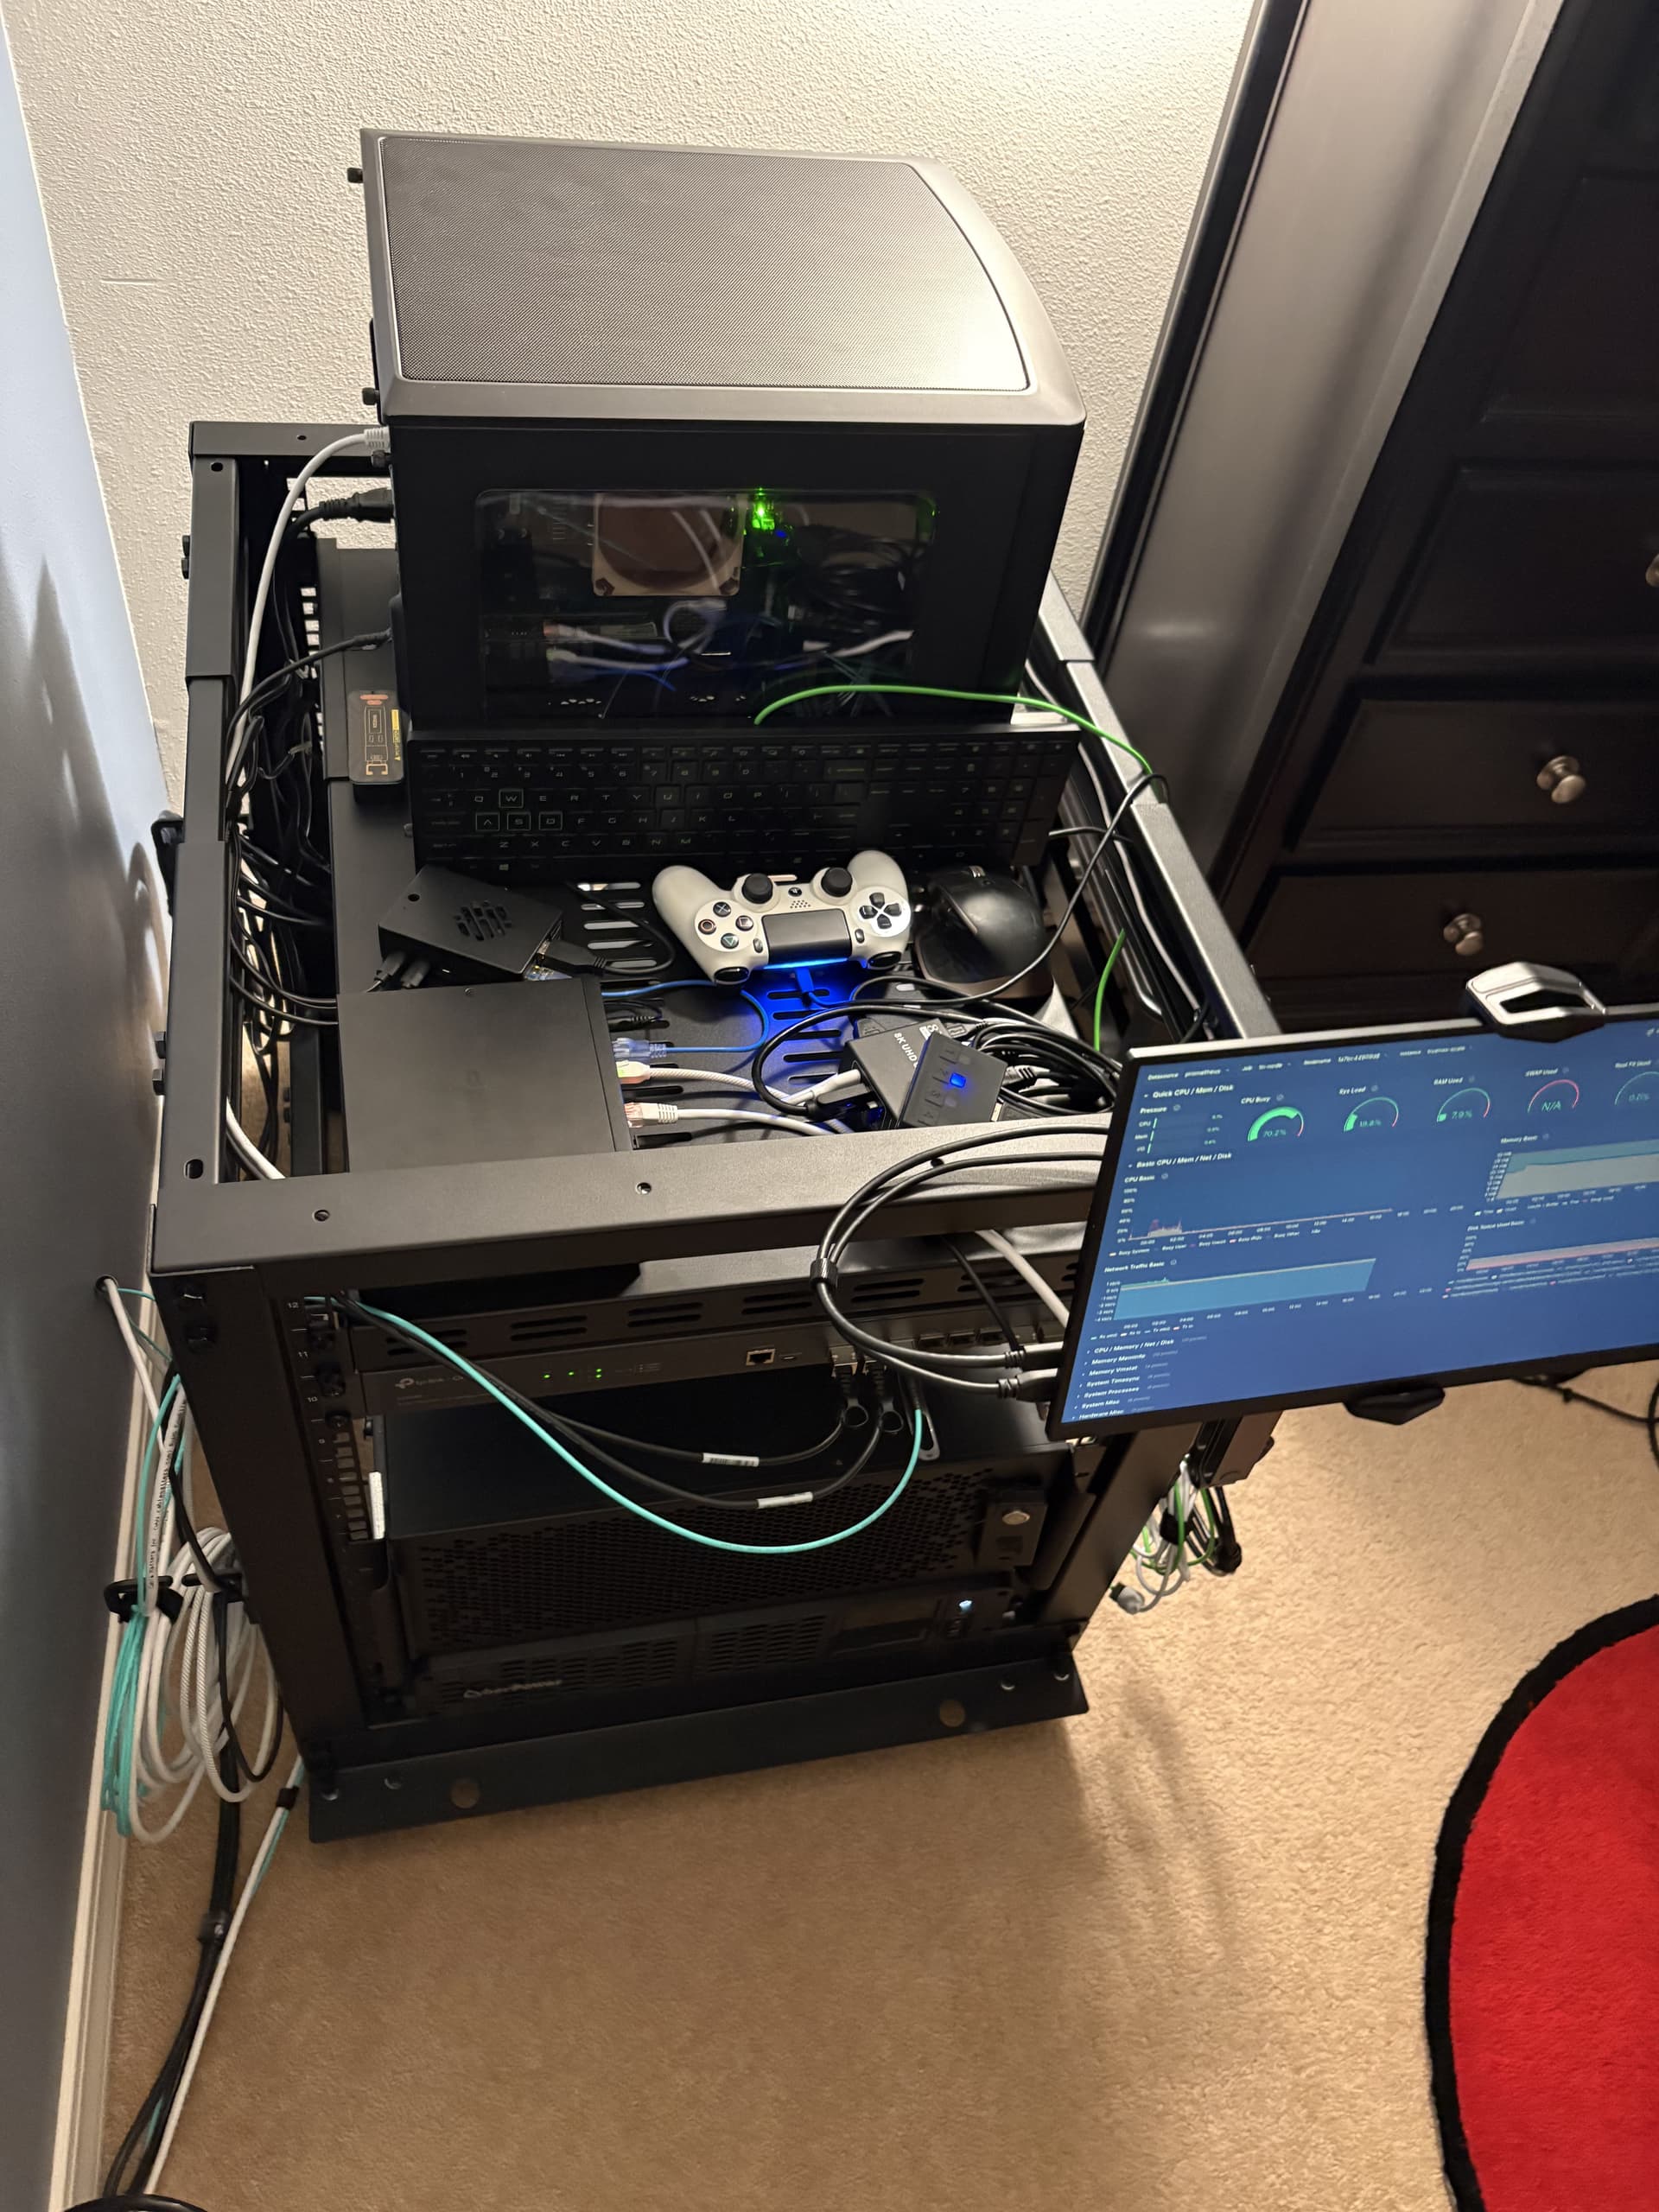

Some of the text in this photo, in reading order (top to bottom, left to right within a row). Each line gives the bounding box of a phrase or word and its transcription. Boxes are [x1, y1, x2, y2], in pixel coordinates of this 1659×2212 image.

[901, 1043, 918, 1061] UHD
[1218, 1084, 1234, 1092] Disk
[1541, 1102, 1562, 1112] N/A
[1113, 1344, 1140, 1352] Memory
[1091, 1357, 1117, 1365] Memory
[1089, 1368, 1115, 1376] Memory
[1086, 1379, 1109, 1388] System
[1082, 1401, 1104, 1409] System
